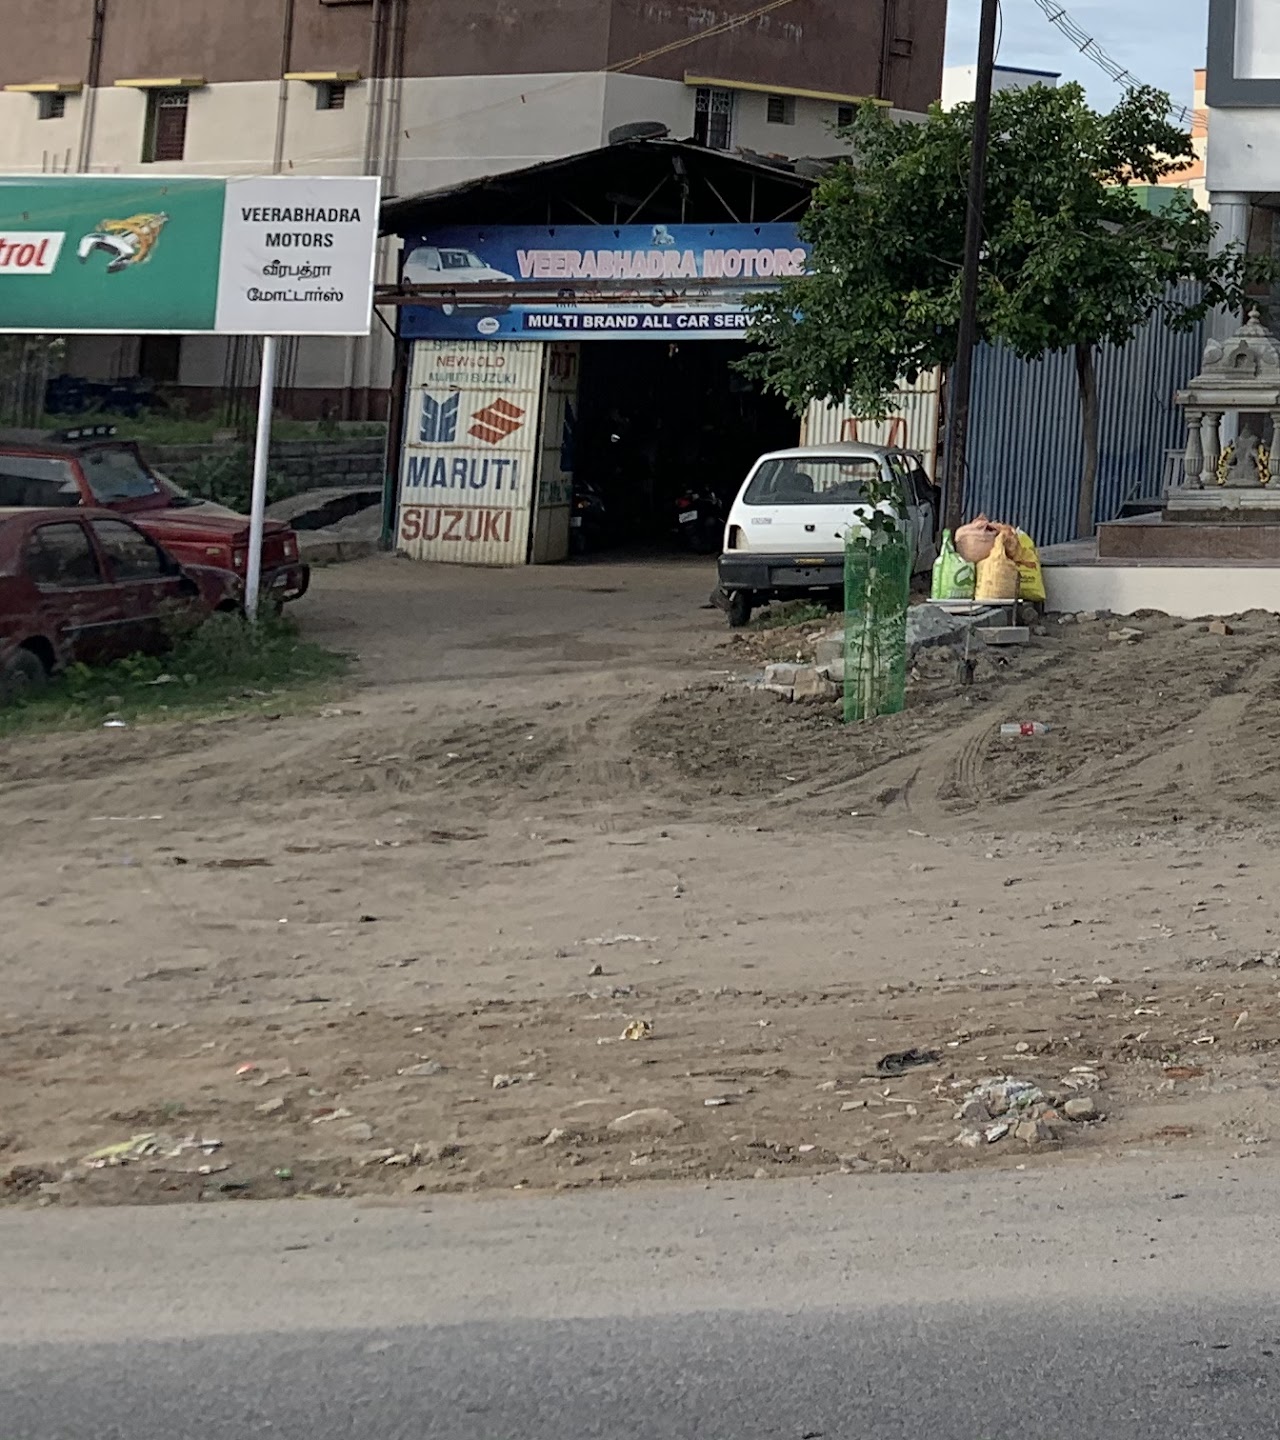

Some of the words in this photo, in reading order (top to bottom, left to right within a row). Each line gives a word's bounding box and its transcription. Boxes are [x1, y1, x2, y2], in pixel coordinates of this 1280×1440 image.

[241, 207, 361, 222] VEERABHADRA
[265, 233, 334, 248] MOTORS
[516, 248, 698, 279] VEERABHADRA
[703, 248, 807, 278] MOTORS
[528, 315, 578, 328] MULTI
[583, 315, 638, 328] BRAND
[642, 315, 672, 328] ALL
[676, 314, 710, 328] CAR
[436, 356, 469, 367] NEW
[470, 372, 517, 385] SUZUKI
[406, 456, 518, 490] MARUTI
[401, 509, 512, 542] SUZUKI
